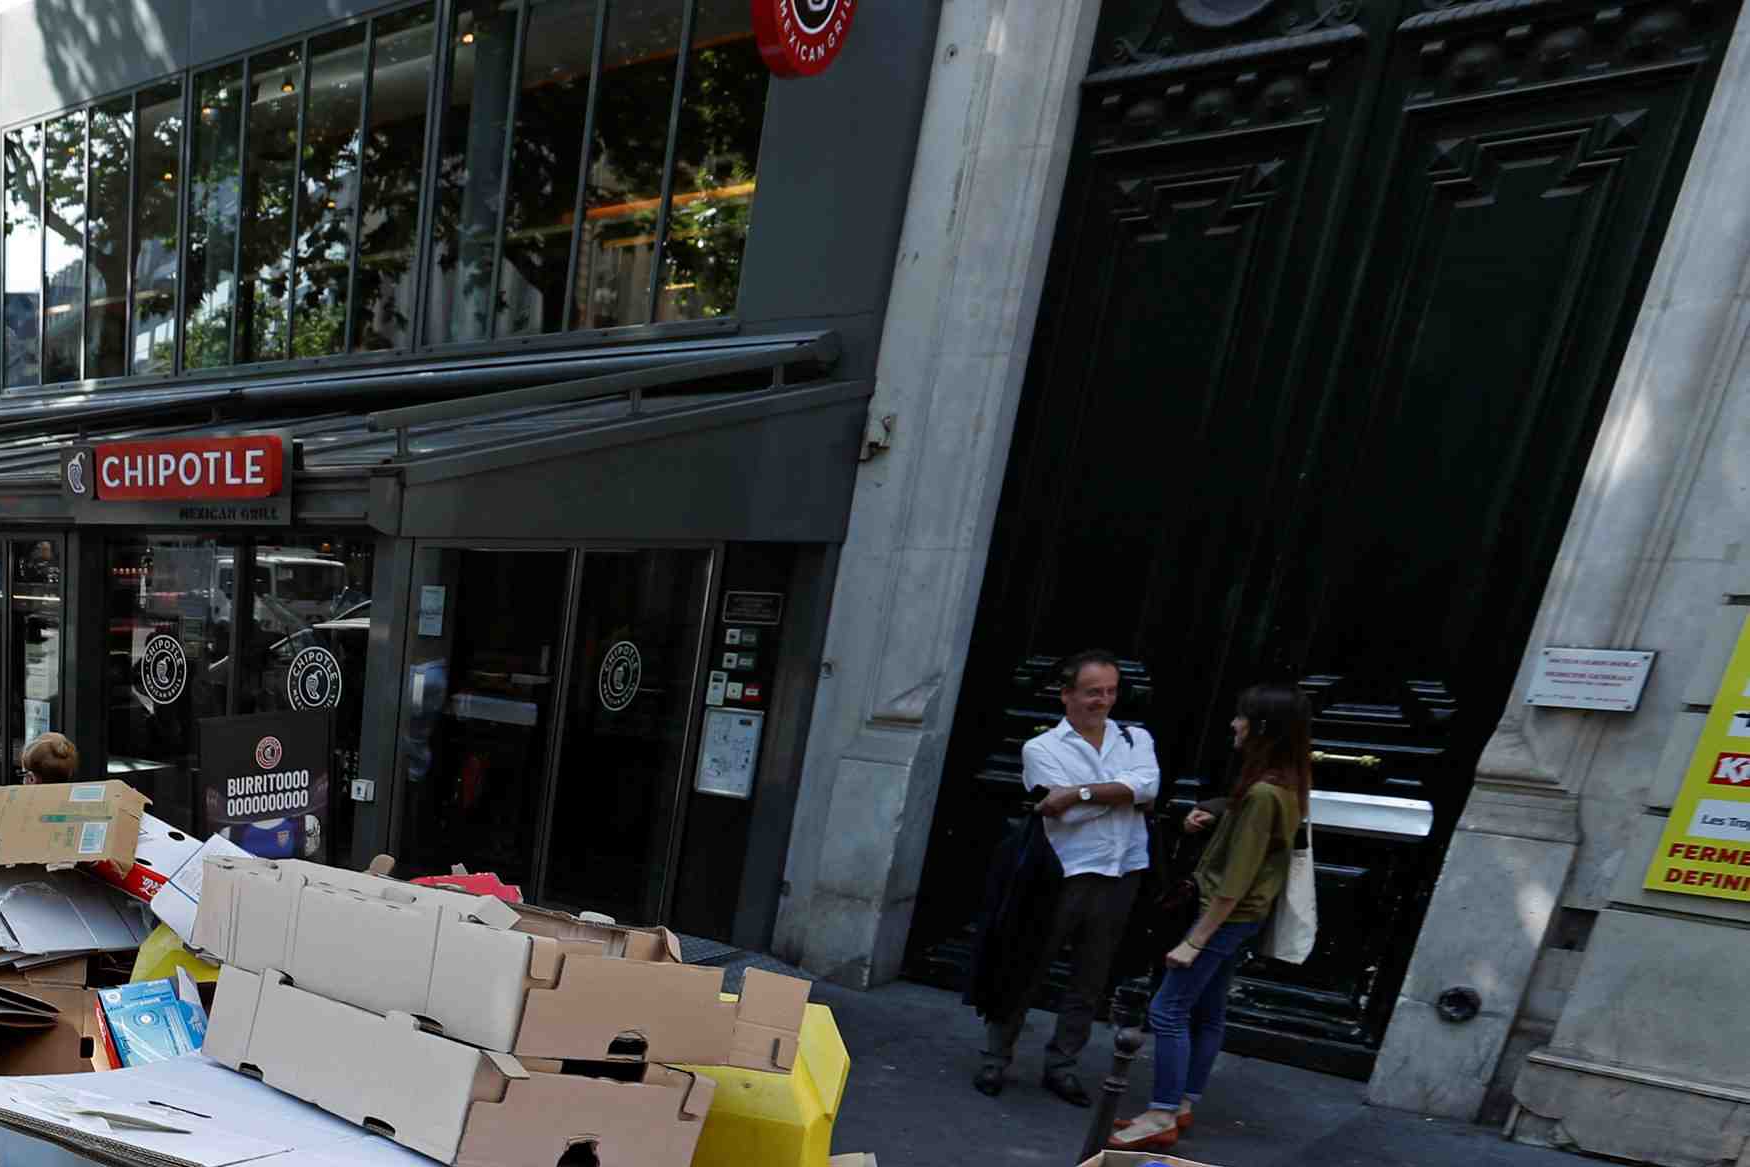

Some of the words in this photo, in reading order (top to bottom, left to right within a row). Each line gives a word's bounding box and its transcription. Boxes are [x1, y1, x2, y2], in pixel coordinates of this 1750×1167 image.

[102, 449, 264, 488] CHIPOTLE
[145, 640, 182, 666] CHIPOTLE
[292, 651, 338, 681] CHIPOTLE
